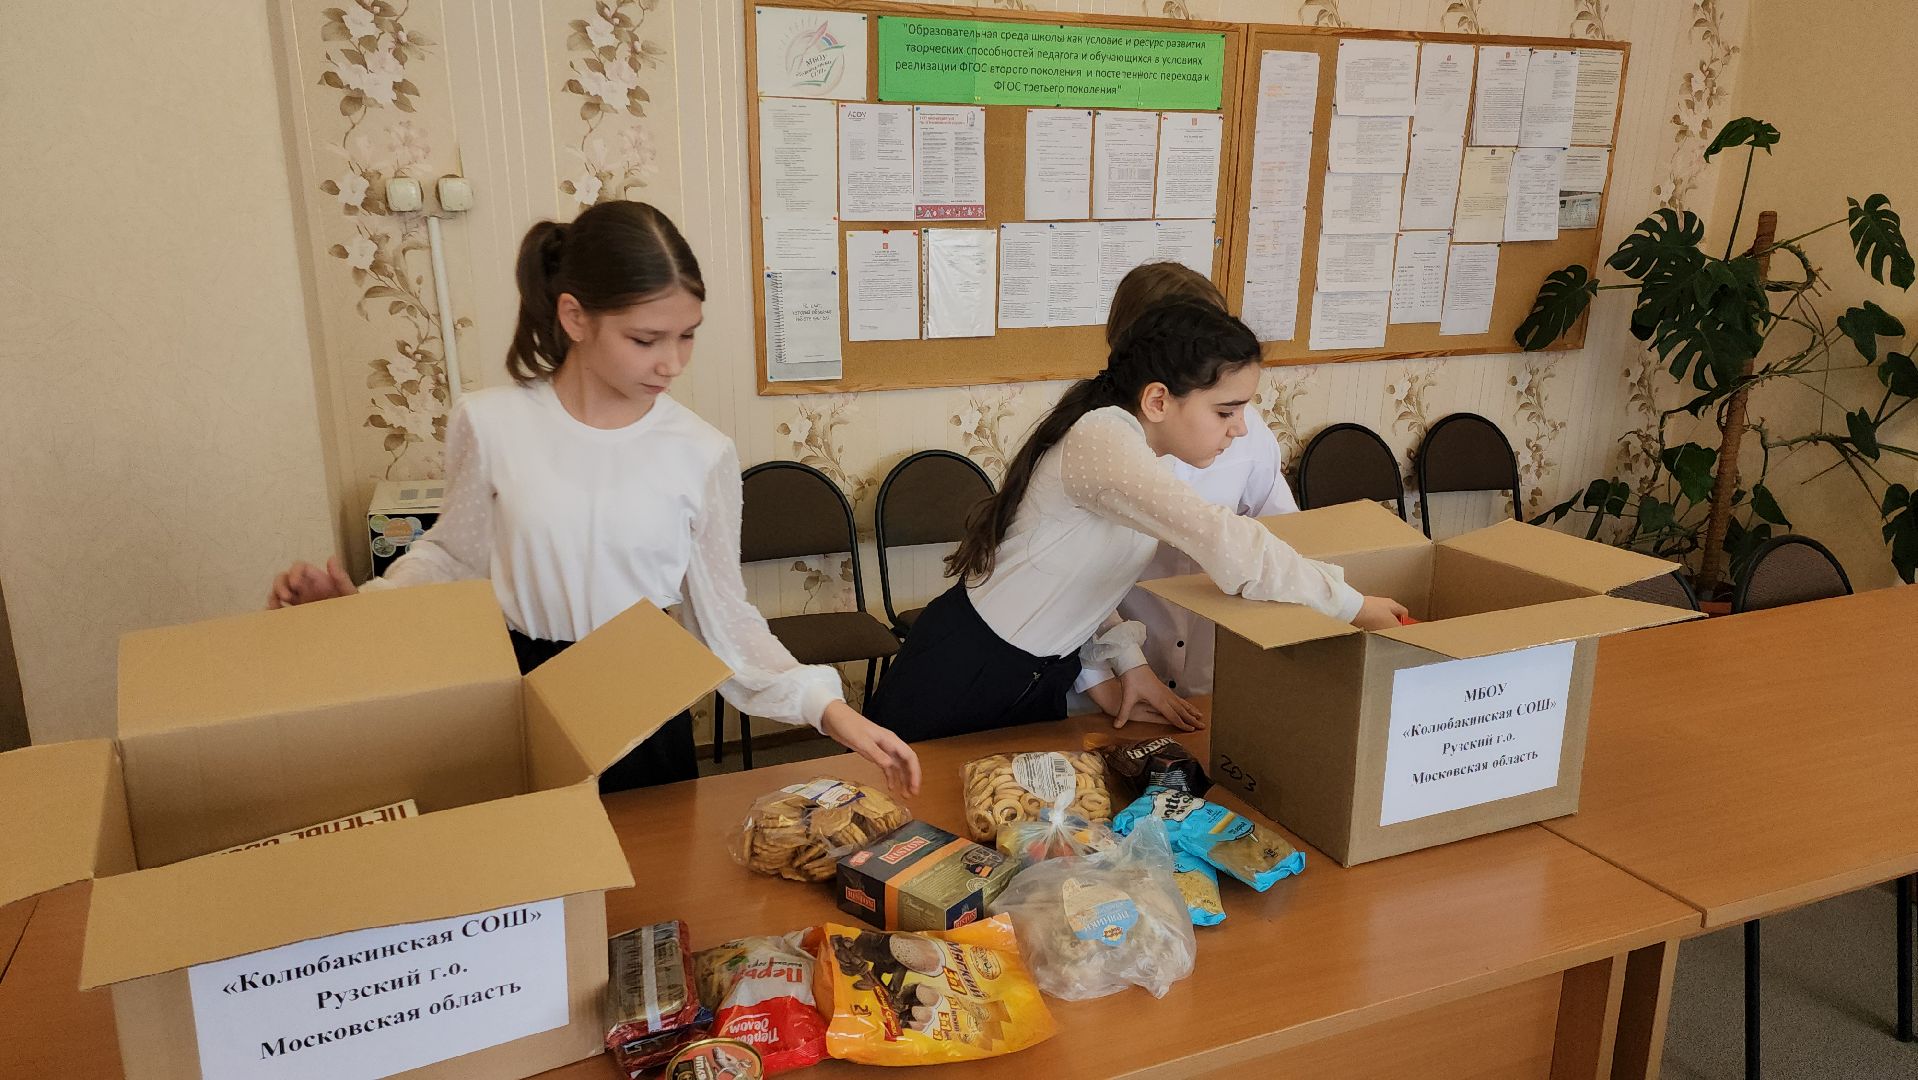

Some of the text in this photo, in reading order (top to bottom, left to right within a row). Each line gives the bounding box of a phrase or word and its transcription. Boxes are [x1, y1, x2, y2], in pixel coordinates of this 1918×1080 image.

[1001, 32, 1029, 42] среда
[1031, 33, 1065, 42] школы
[1067, 35, 1083, 43] как
[1086, 36, 1123, 47] условие
[1126, 38, 1132, 46] и
[1134, 38, 1164, 49] ресурс
[1166, 40, 1206, 50] развития
[906, 44, 964, 55] творческих
[966, 46, 1034, 58] способностей
[1037, 50, 1079, 60] педагога
[1089, 51, 1152, 64] обучающихся
[1162, 56, 1203, 68] условиях
[895, 61, 957, 72] реализации
[960, 62, 988, 73] ФГОС
[990, 65, 1028, 76] второго
[1030, 67, 1082, 77] поколения
[1160, 72, 1203, 82] перехода
[993, 81, 1122, 96] ФГОС третьего поколения"
[1464, 682, 1508, 703] МБОУ
[1402, 698, 1557, 739] «Колюбакинская СОШ»
[1442, 733, 1516, 757] Рузский г.о.
[1220, 754, 1257, 792] 203
[1411, 750, 1539, 786] Московская область
[884, 838, 927, 864] RISTON
[222, 908, 542, 996] «Колюбакинская СОШ»
[316, 962, 468, 1011] Рузский г.о.
[259, 981, 522, 1060] Московская область
